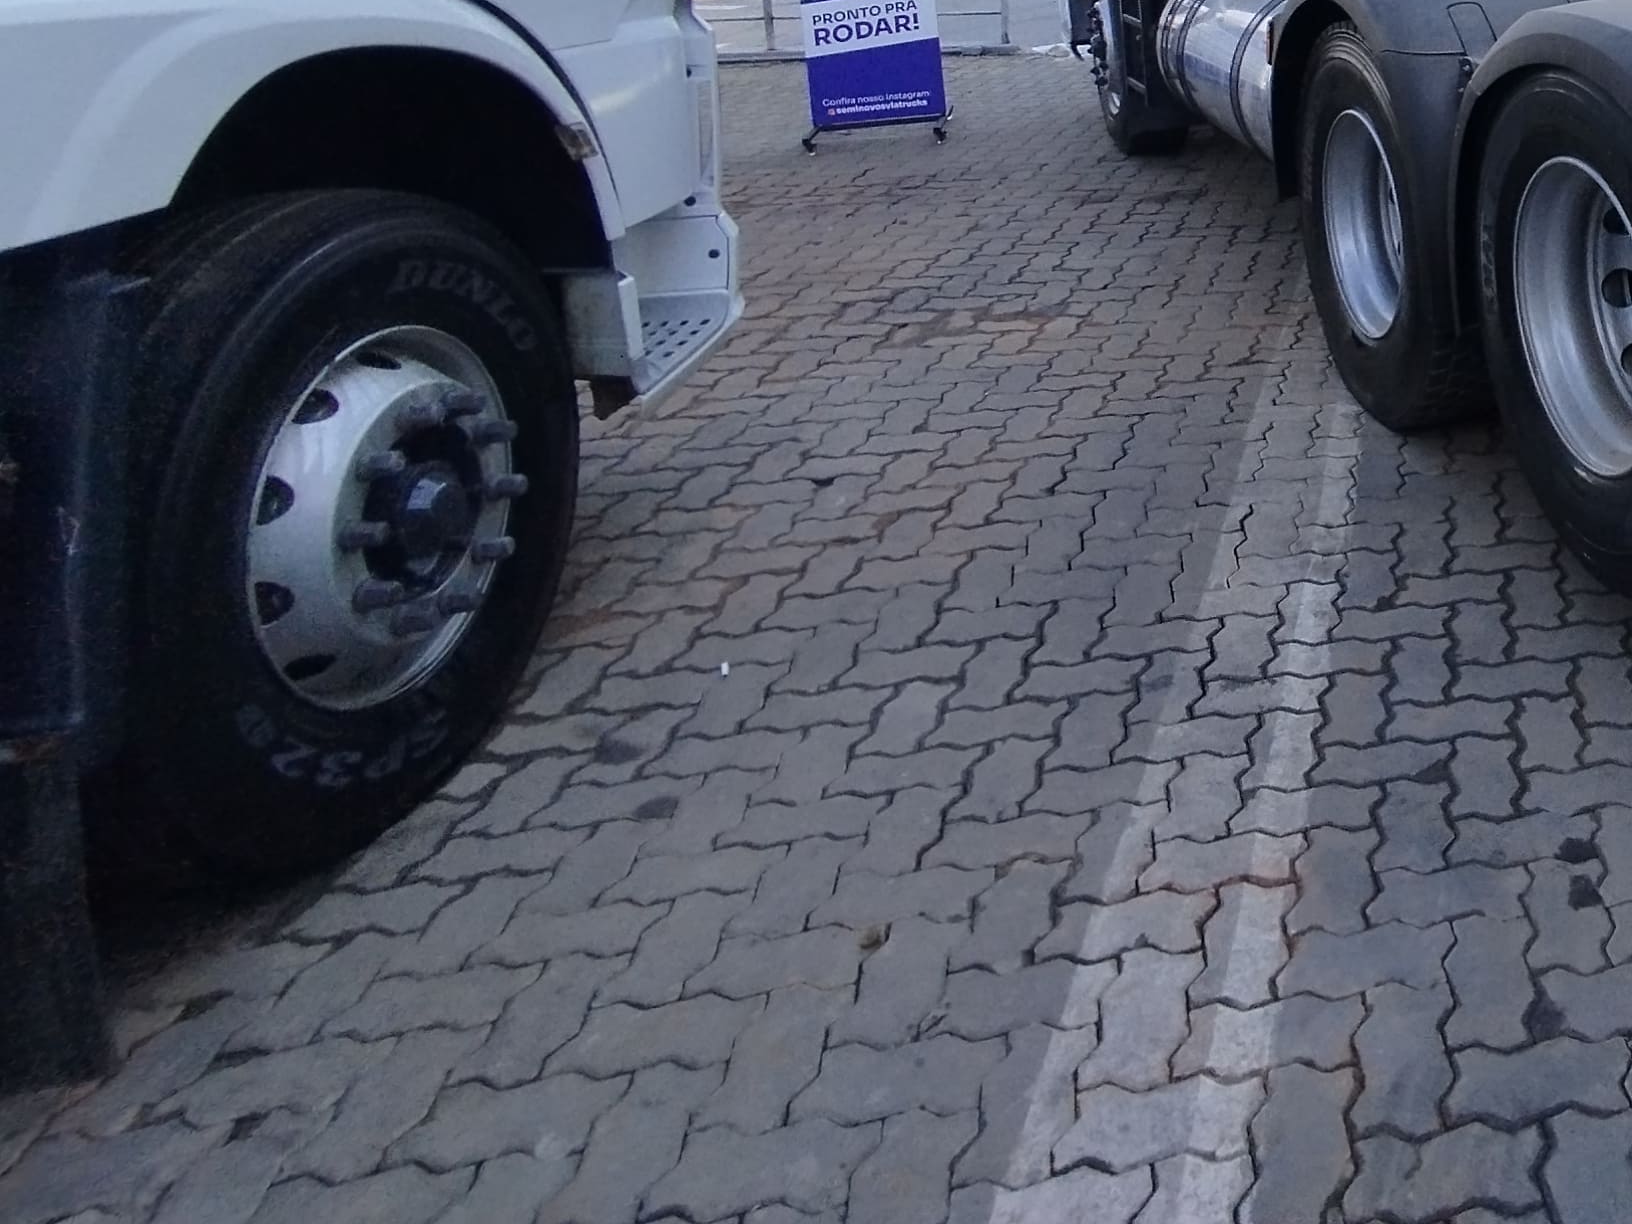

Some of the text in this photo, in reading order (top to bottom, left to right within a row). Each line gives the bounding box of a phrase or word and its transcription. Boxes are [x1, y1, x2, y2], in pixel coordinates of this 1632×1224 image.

[812, 0, 918, 26] PRONTO PRA
[813, 12, 920, 47] RODAR!
[822, 97, 856, 107] Confira
[857, 95, 885, 104] nosso
[383, 259, 540, 352] DUNLO
